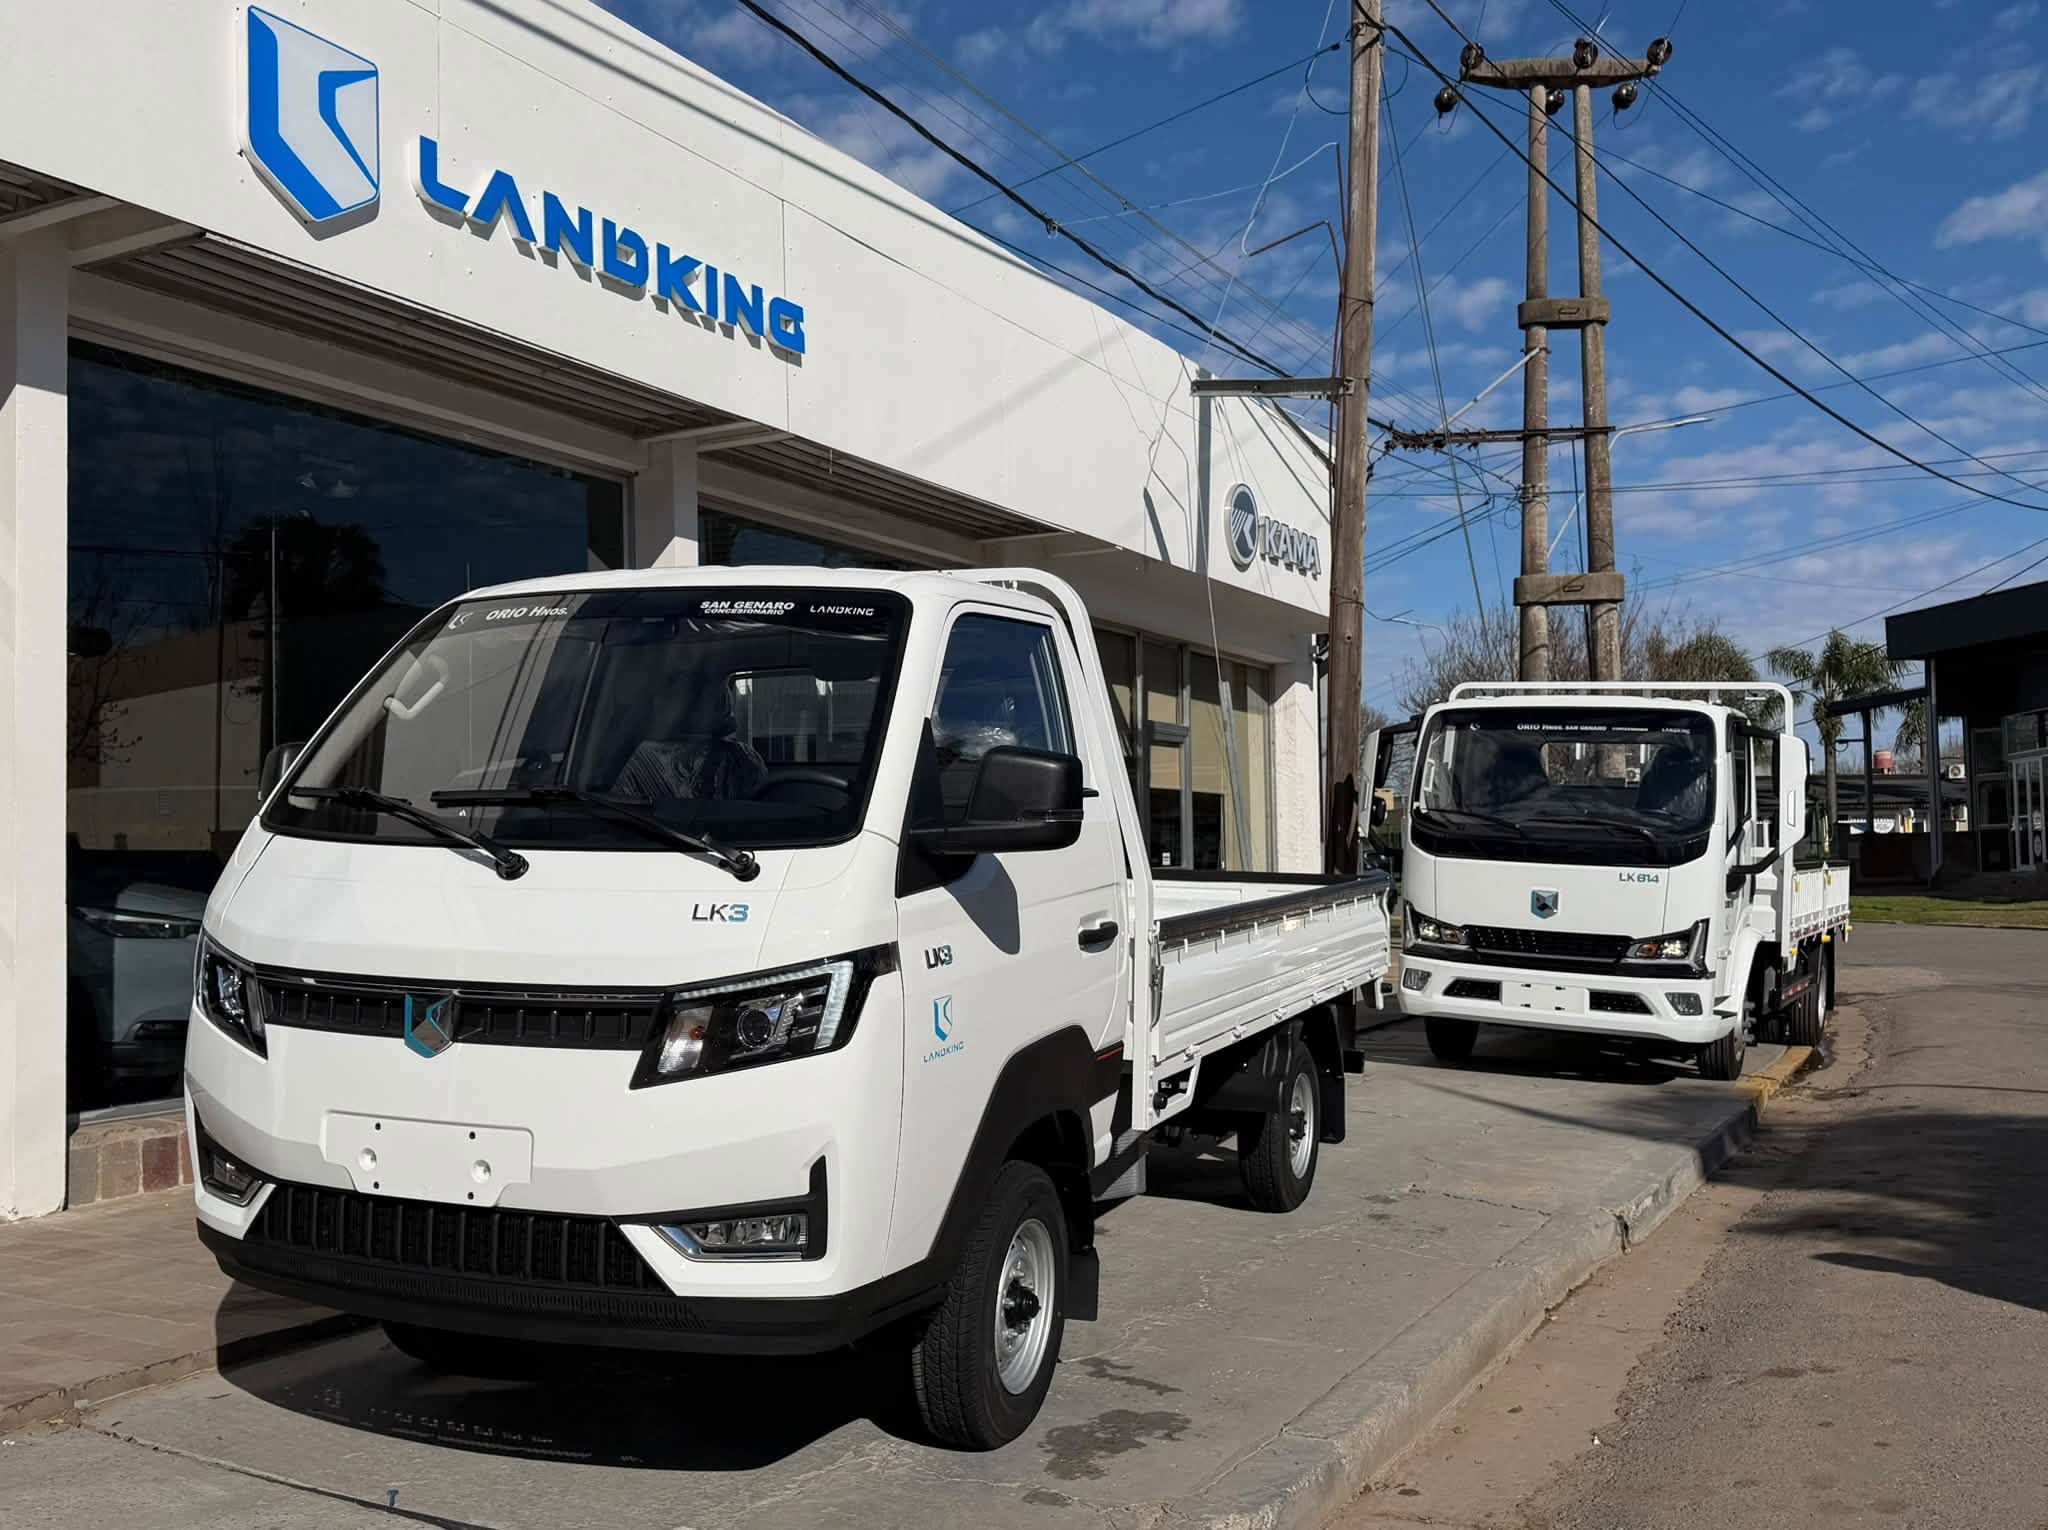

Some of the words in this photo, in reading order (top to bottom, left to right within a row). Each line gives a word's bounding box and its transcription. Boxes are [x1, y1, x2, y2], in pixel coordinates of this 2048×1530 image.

[418, 133, 806, 355] LANDKING
[1262, 515, 1321, 577] KAMA
[485, 607, 528, 621] ORIO
[700, 600, 731, 610] SAN
[733, 600, 795, 610] GENARO
[809, 605, 875, 616] LANDKING
[691, 903, 750, 922] LK3
[924, 944, 953, 969] LK3
[923, 1041, 964, 1063] LANDKING
